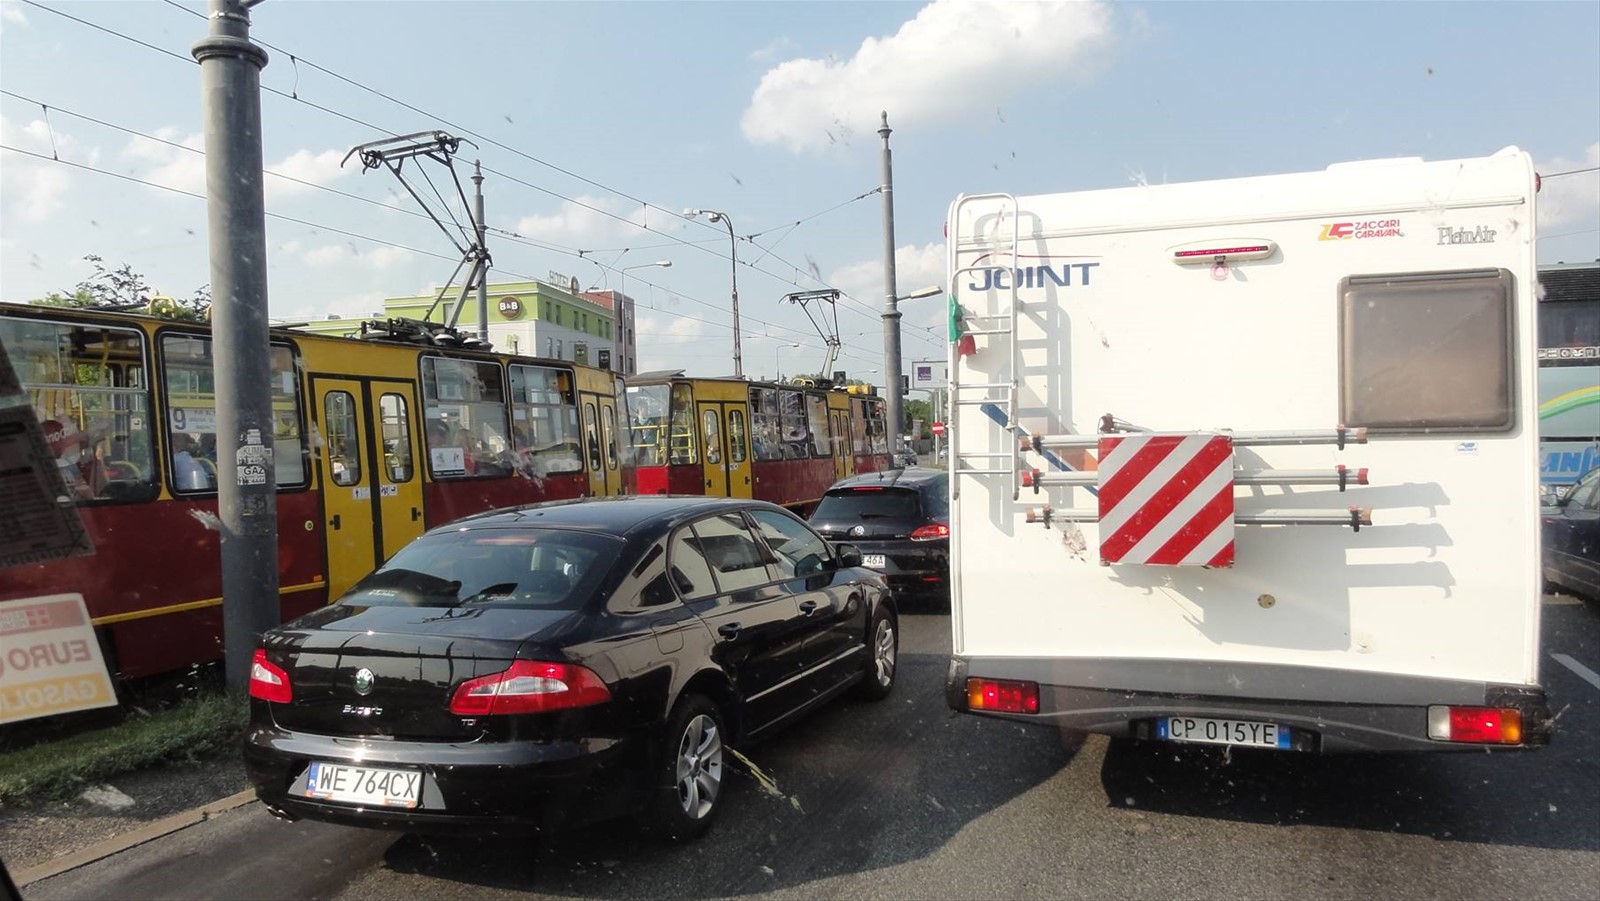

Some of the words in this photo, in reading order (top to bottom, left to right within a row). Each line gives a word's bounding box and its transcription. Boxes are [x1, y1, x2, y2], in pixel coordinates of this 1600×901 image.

[1355, 219, 1400, 230] ZACCARI
[1354, 229, 1400, 239] CARAVAN
[968, 262, 1100, 291] JOINT
[499, 302, 518, 311] B&B
[173, 408, 187, 430] 9
[243, 467, 264, 475] GAZ
[1171, 718, 1196, 738] CP
[1206, 721, 1275, 745] 015YE
[320, 766, 348, 792] WE
[353, 770, 418, 799] 764CX
